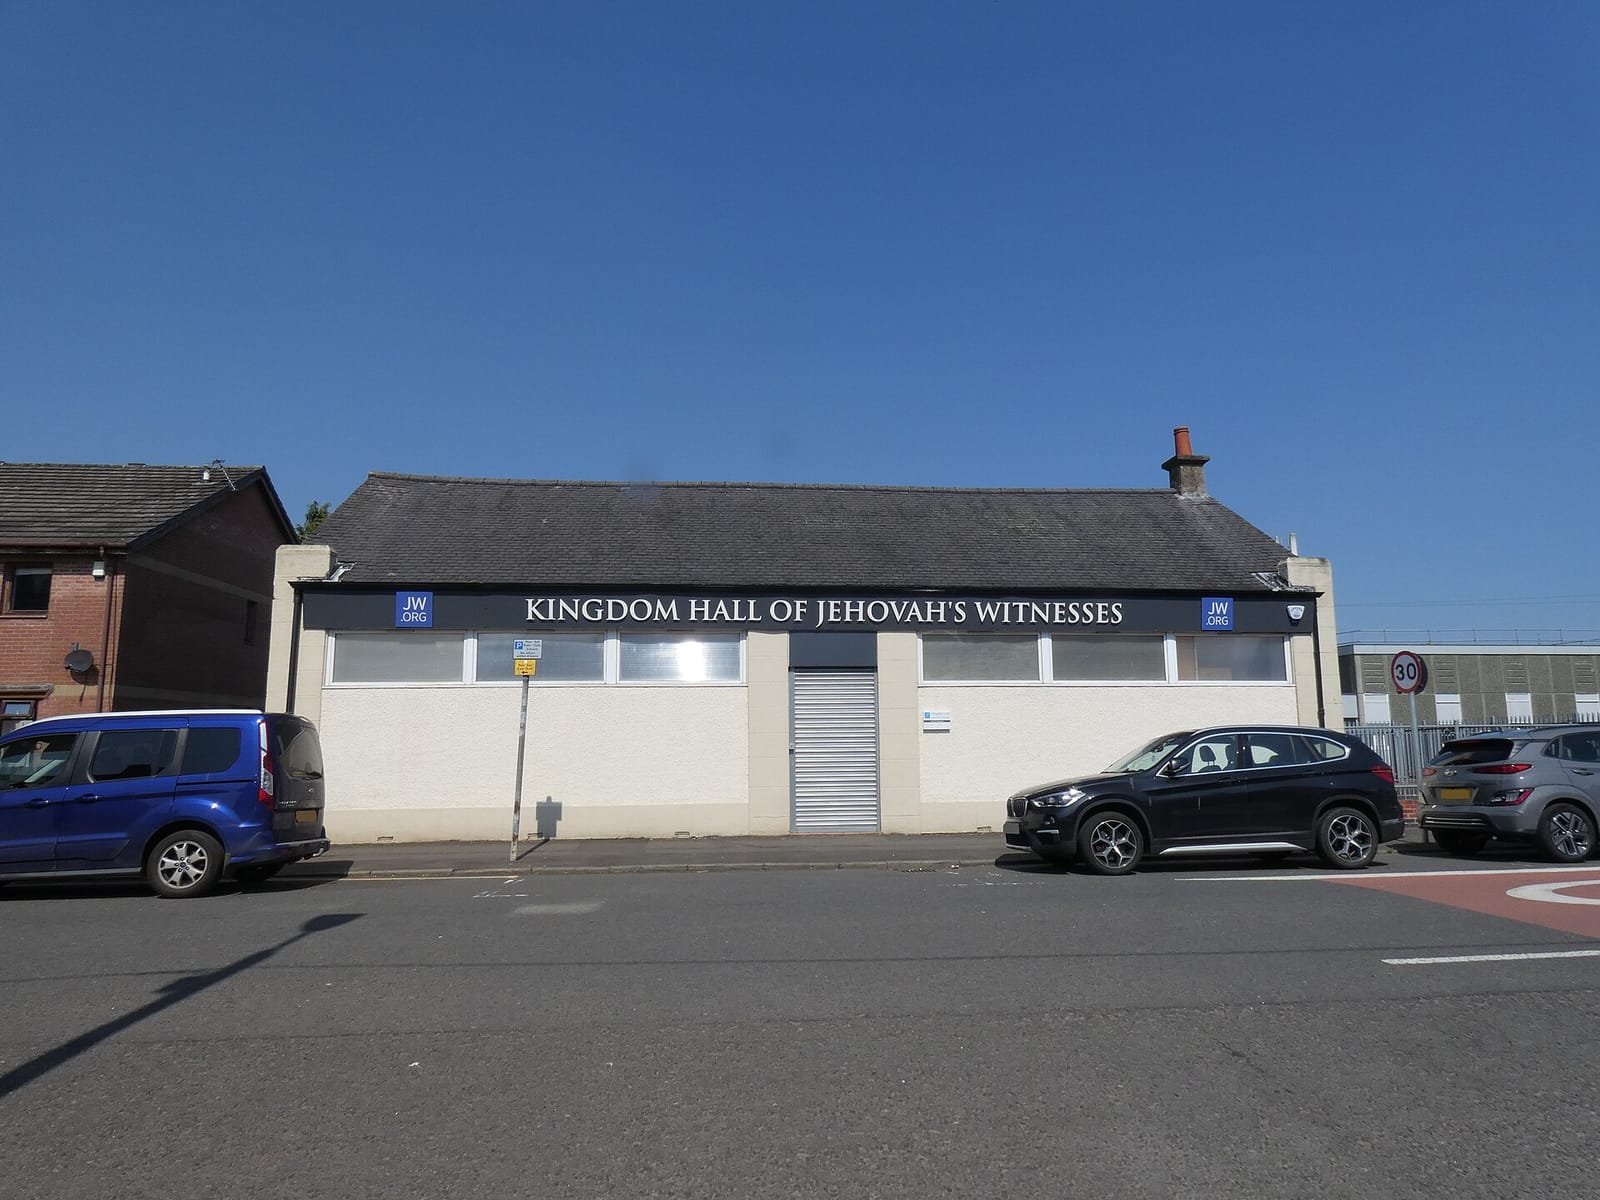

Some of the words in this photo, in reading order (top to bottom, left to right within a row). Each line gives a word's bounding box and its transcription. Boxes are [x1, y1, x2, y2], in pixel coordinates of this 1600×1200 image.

[402, 596, 427, 611] JW
[1207, 601, 1229, 615] JW
[400, 611, 427, 622] .ORG
[525, 598, 680, 621] KINGDOM
[688, 599, 762, 621] HALL
[769, 600, 808, 622] OF
[815, 600, 967, 629] JEHOVAH'S
[974, 601, 1123, 624] WITNESSES
[1205, 615, 1229, 626] .ORG
[1395, 662, 1417, 681] 30
